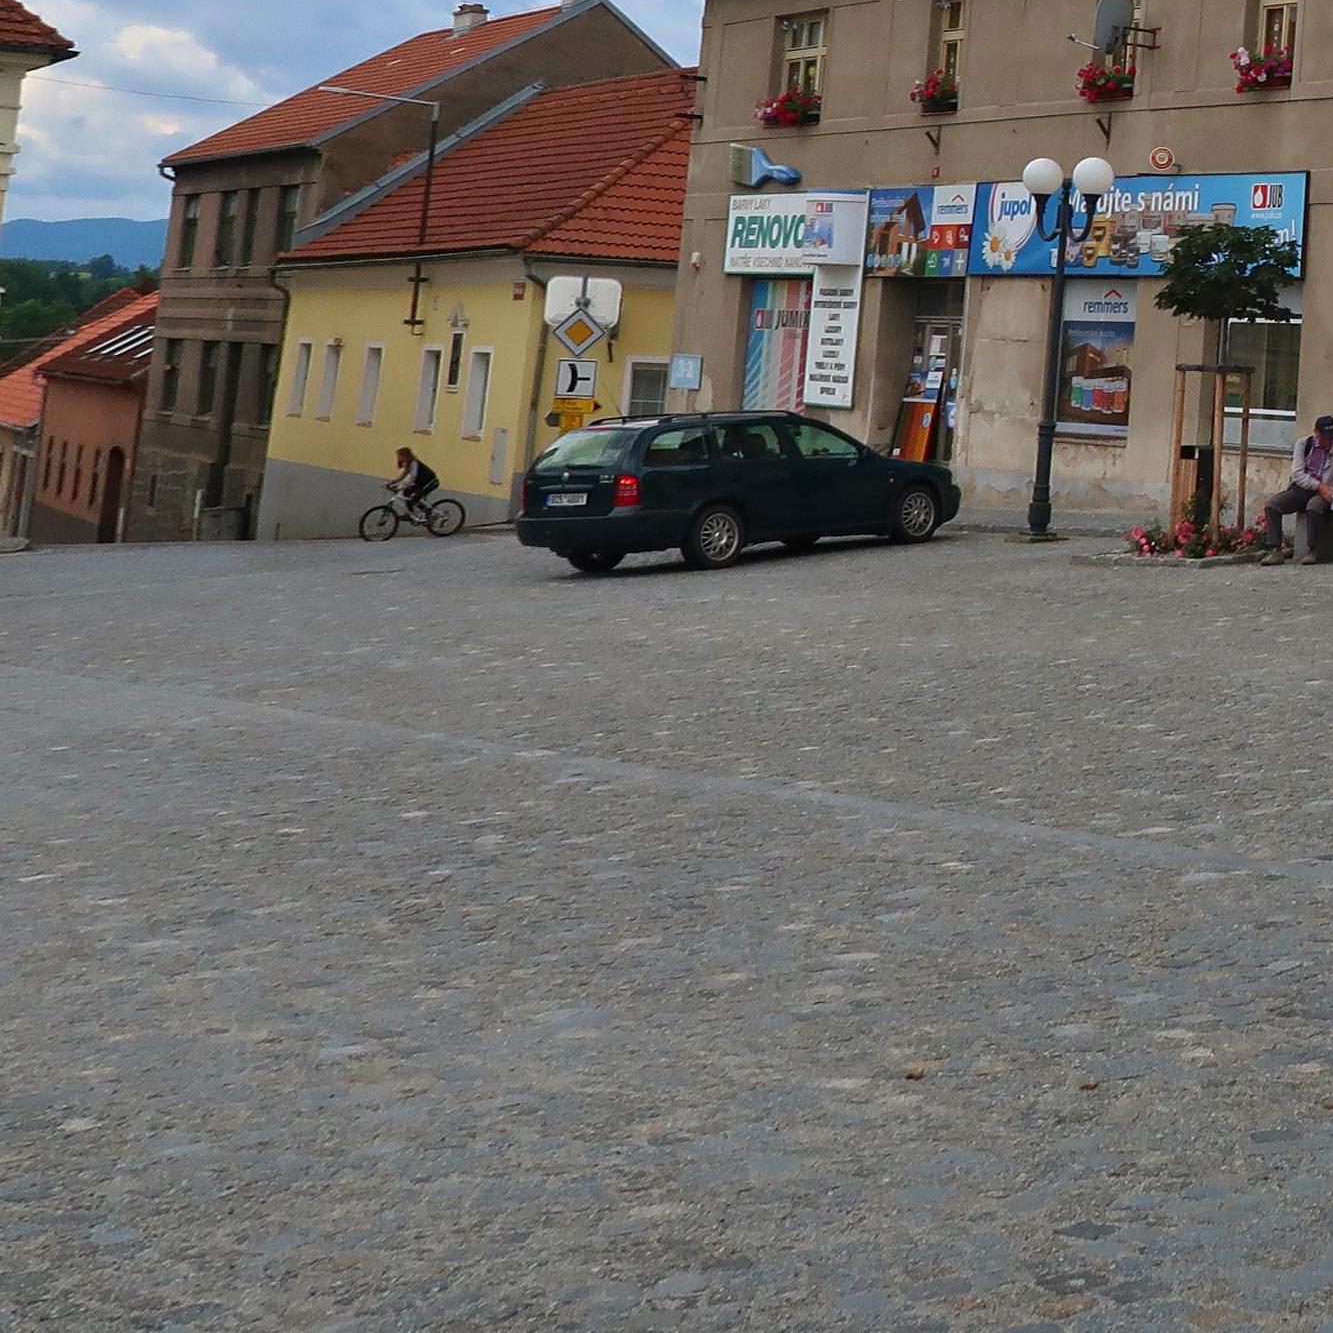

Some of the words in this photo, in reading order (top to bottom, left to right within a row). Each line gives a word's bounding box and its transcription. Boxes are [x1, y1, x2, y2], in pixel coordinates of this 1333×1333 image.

[998, 192, 1032, 220] jupol
[1068, 186, 1132, 218] Maujte
[1138, 191, 1145, 212] s
[1151, 183, 1200, 212] námi
[1083, 300, 1129, 314] remmers
